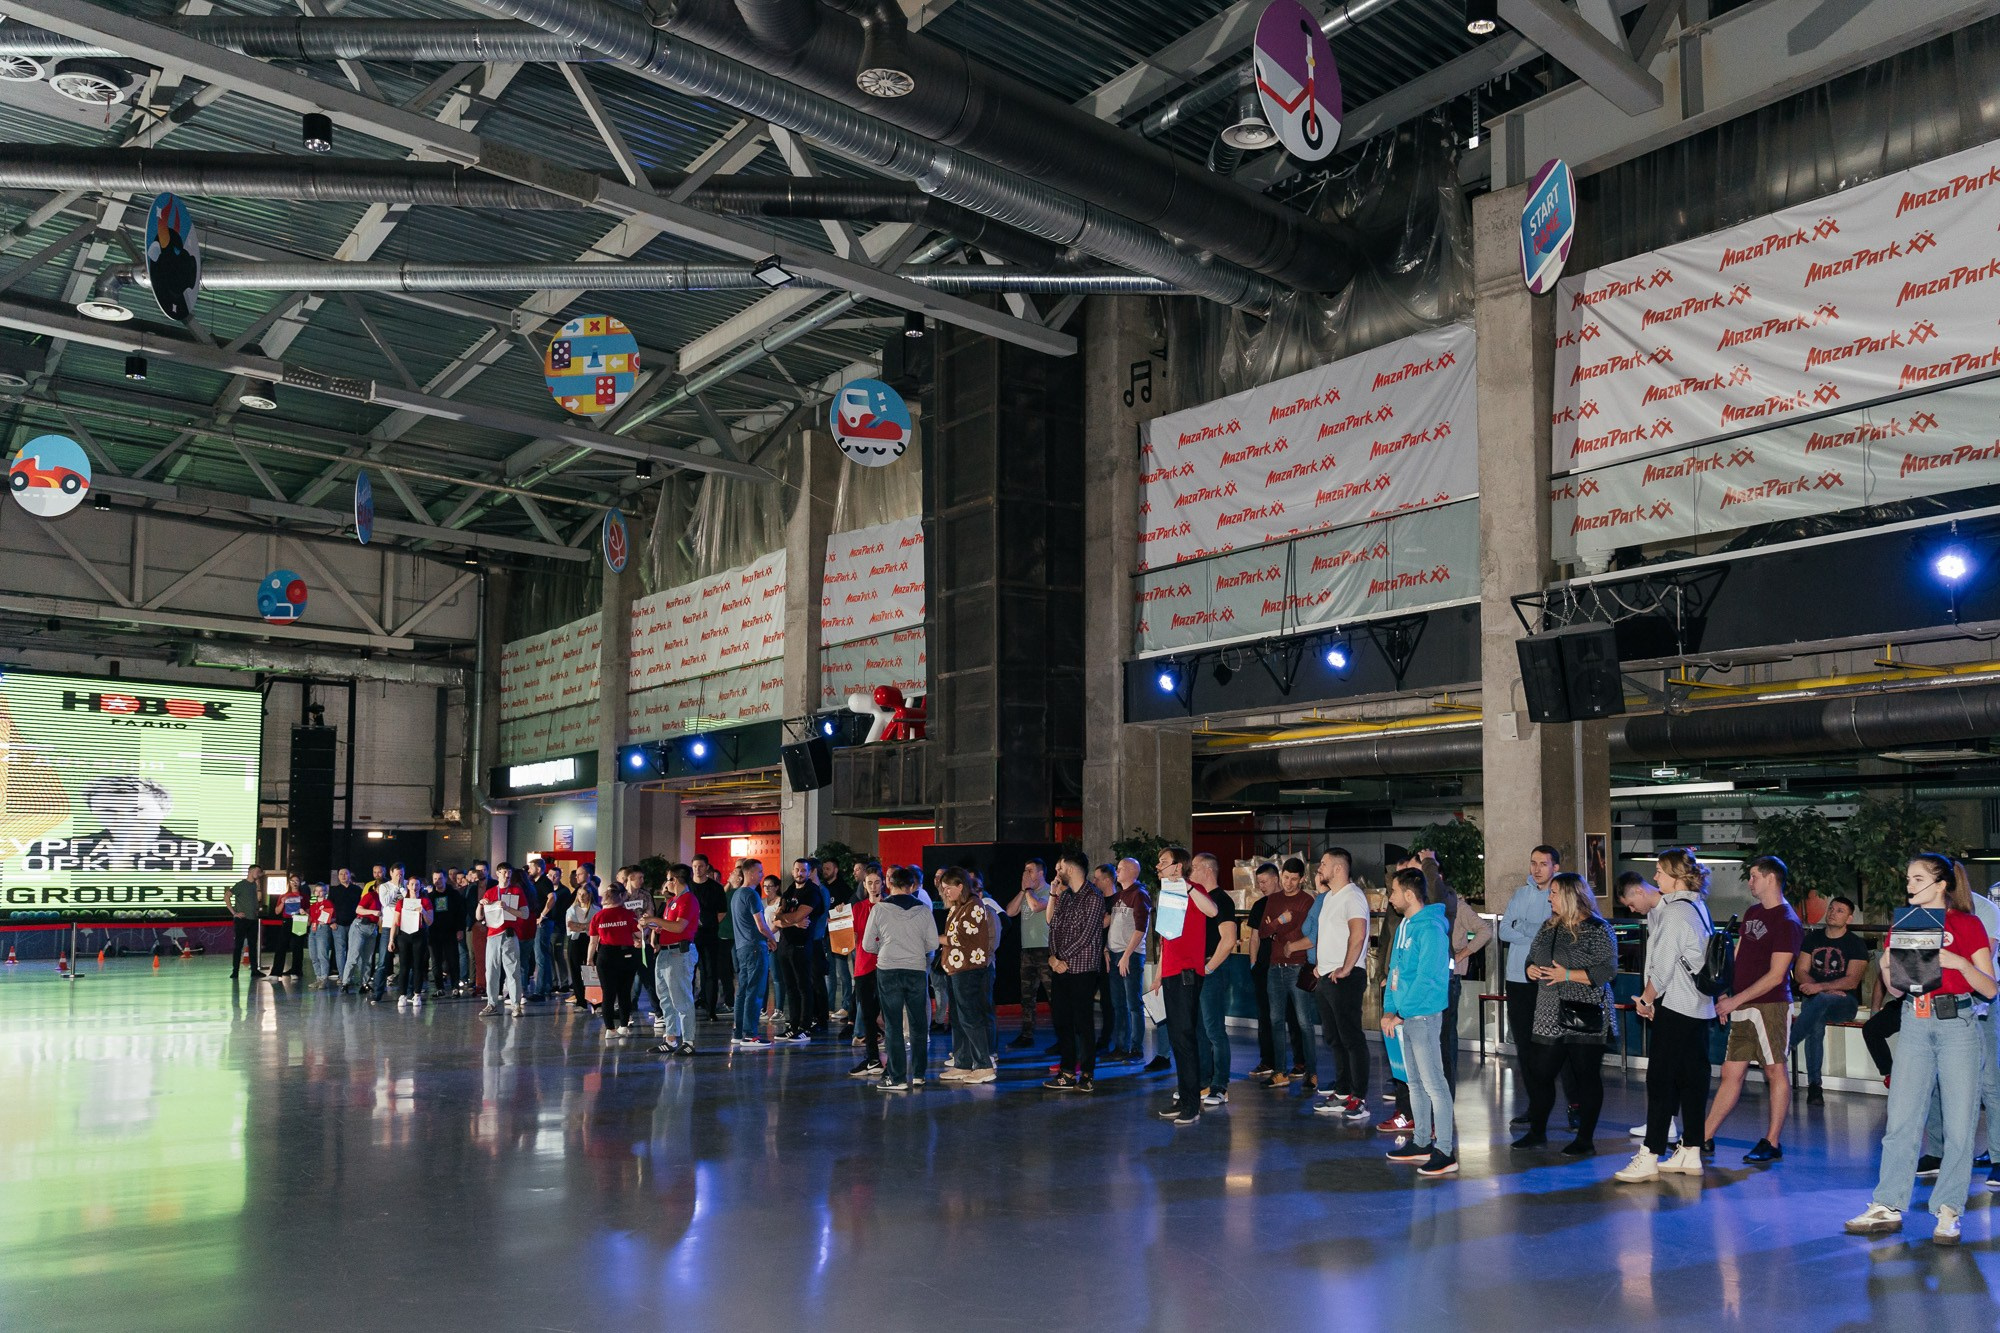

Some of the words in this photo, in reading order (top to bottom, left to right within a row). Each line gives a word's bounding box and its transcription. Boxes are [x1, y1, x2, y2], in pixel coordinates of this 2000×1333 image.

[1530, 183, 1559, 237] START
[1719, 228, 1809, 272] MazaPark
[1804, 241, 1902, 288] MazaPark
[1571, 276, 1646, 311] MazaPark
[1641, 292, 1725, 331] MazaPark
[1717, 312, 1810, 351] MazaPark
[1805, 330, 1905, 372] MazaPark
[1570, 351, 1647, 387] MazaPark
[1641, 373, 1726, 407] MazaPark
[1720, 390, 1807, 428] MazaPark
[1570, 424, 1647, 459] MazaPark
[1804, 418, 1906, 455] MazaPark
[1641, 452, 1724, 487] MazaPark
[1719, 475, 1810, 510] MazaPark
[1570, 504, 1645, 537] MazaPark
[0, 838, 233, 857] УРГАОВА
[22, 856, 216, 872] ОРКСТР
[6, 886, 232, 905] GROUP.RU
[598, 920, 628, 929] ANIMATOR
